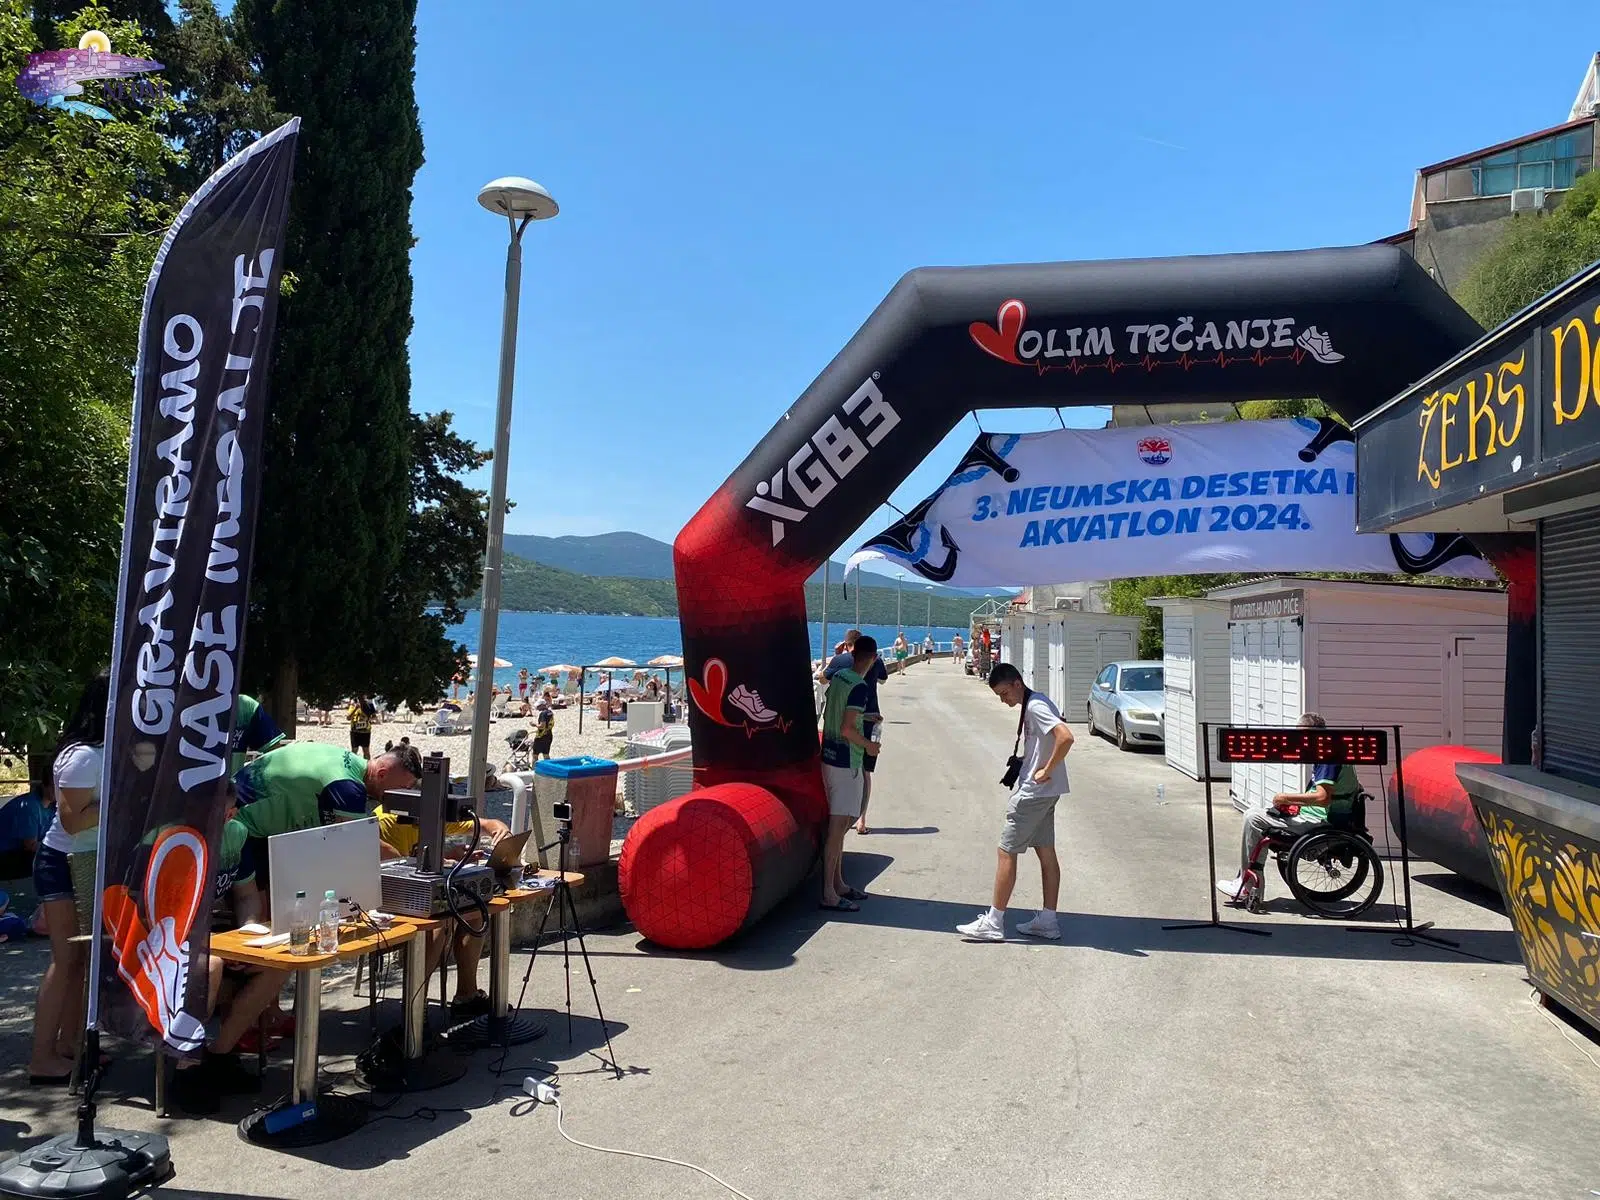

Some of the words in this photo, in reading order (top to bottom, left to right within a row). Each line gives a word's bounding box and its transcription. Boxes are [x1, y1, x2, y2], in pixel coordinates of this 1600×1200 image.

[1126, 316, 1296, 355] TRČANJE
[1417, 348, 1525, 490] ŽEKS
[971, 494, 999, 522] 3.
[1006, 477, 1175, 516] NEUMSKA
[1179, 468, 1339, 500] DESETKA
[132, 313, 204, 736] GRAVIRAMO
[1018, 507, 1202, 549] AKVATLON
[1208, 502, 1312, 533] 2024.
[1283, 592, 1299, 614] PIĆE
